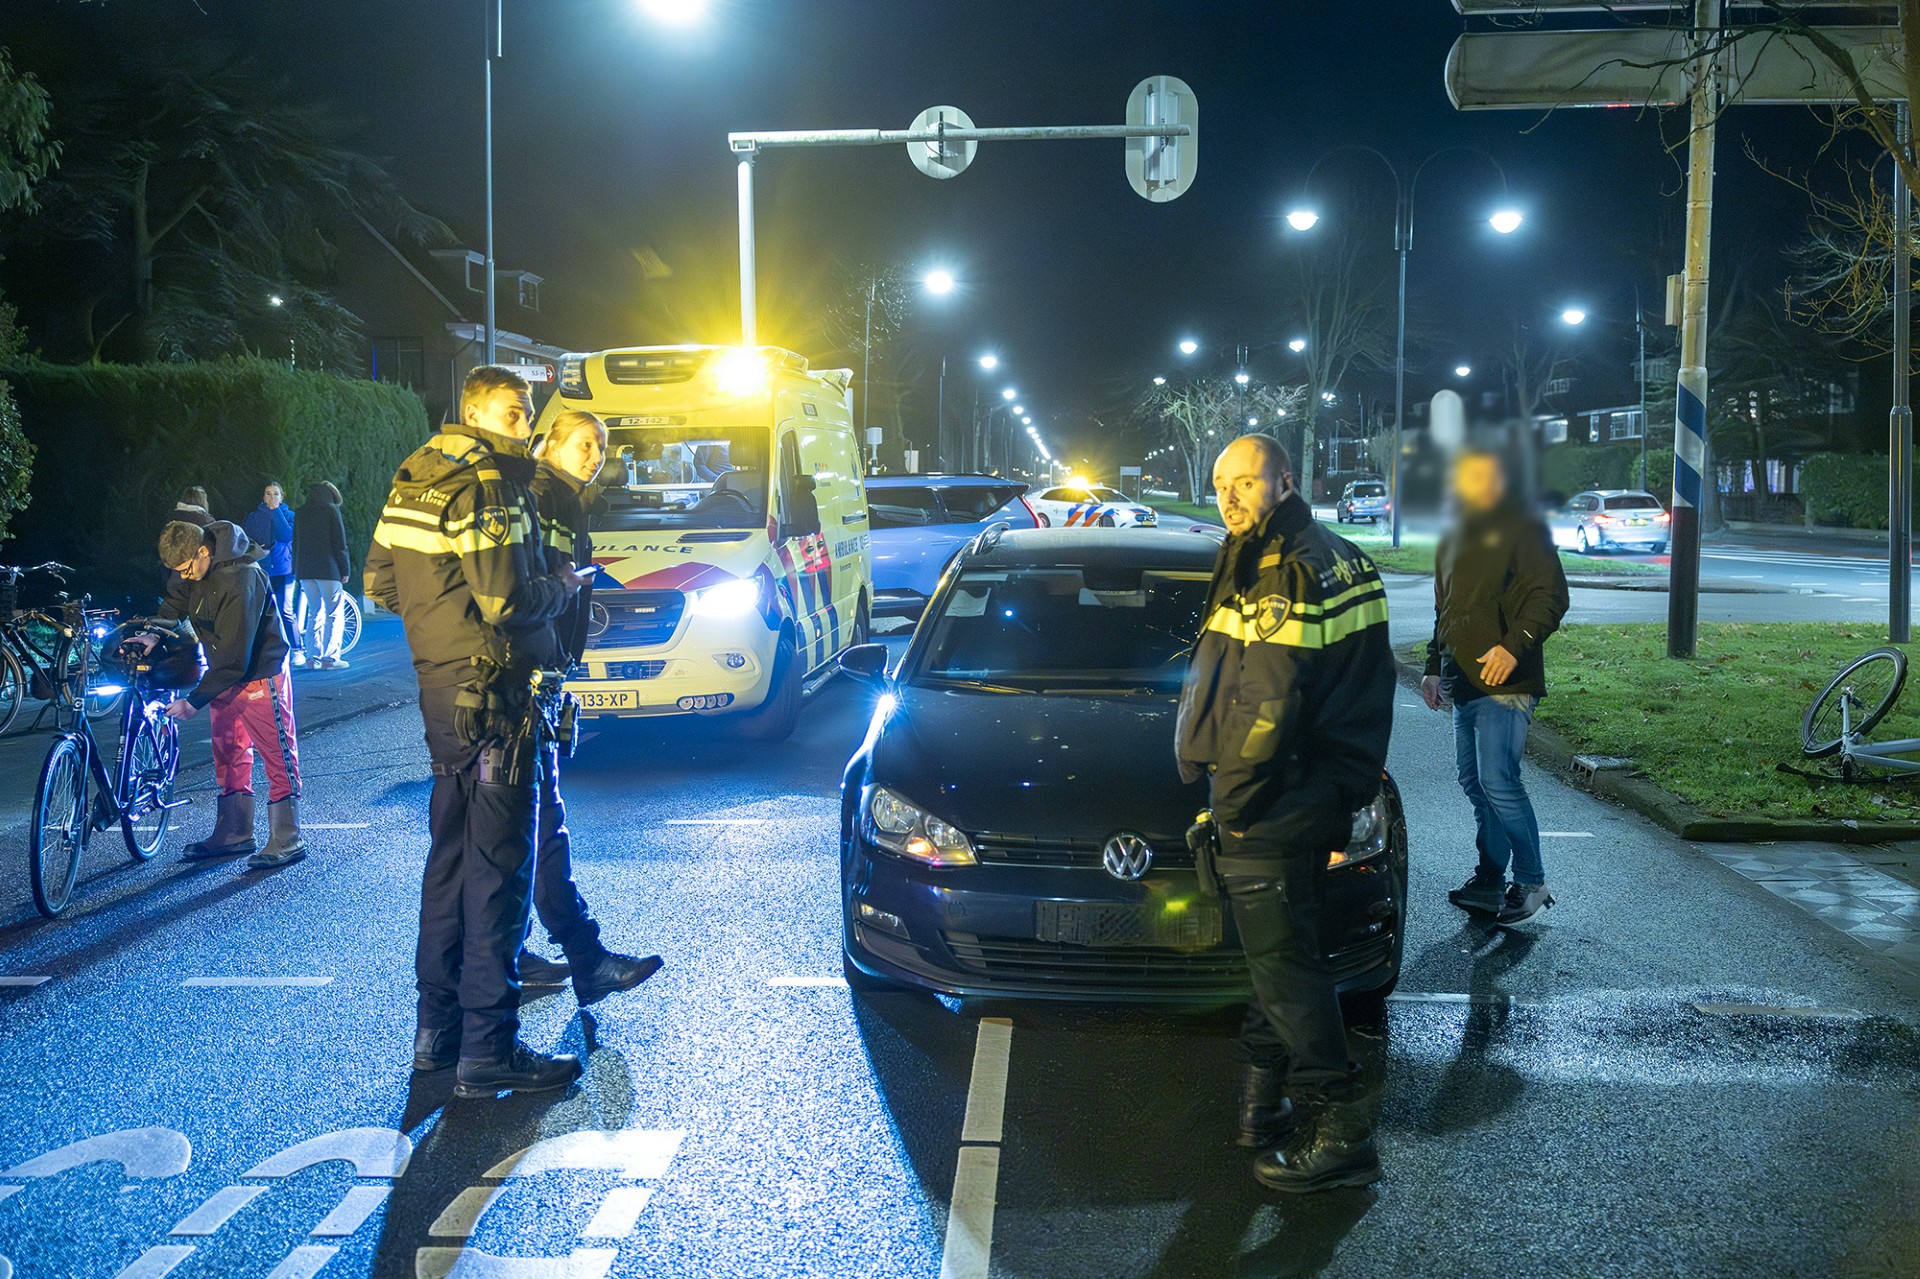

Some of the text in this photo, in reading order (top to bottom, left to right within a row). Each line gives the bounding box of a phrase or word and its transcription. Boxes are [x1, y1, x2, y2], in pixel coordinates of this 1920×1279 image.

[628, 417, 663, 425] 12-142
[592, 544, 694, 554] ULANCE
[579, 693, 628, 707] -133-XP
